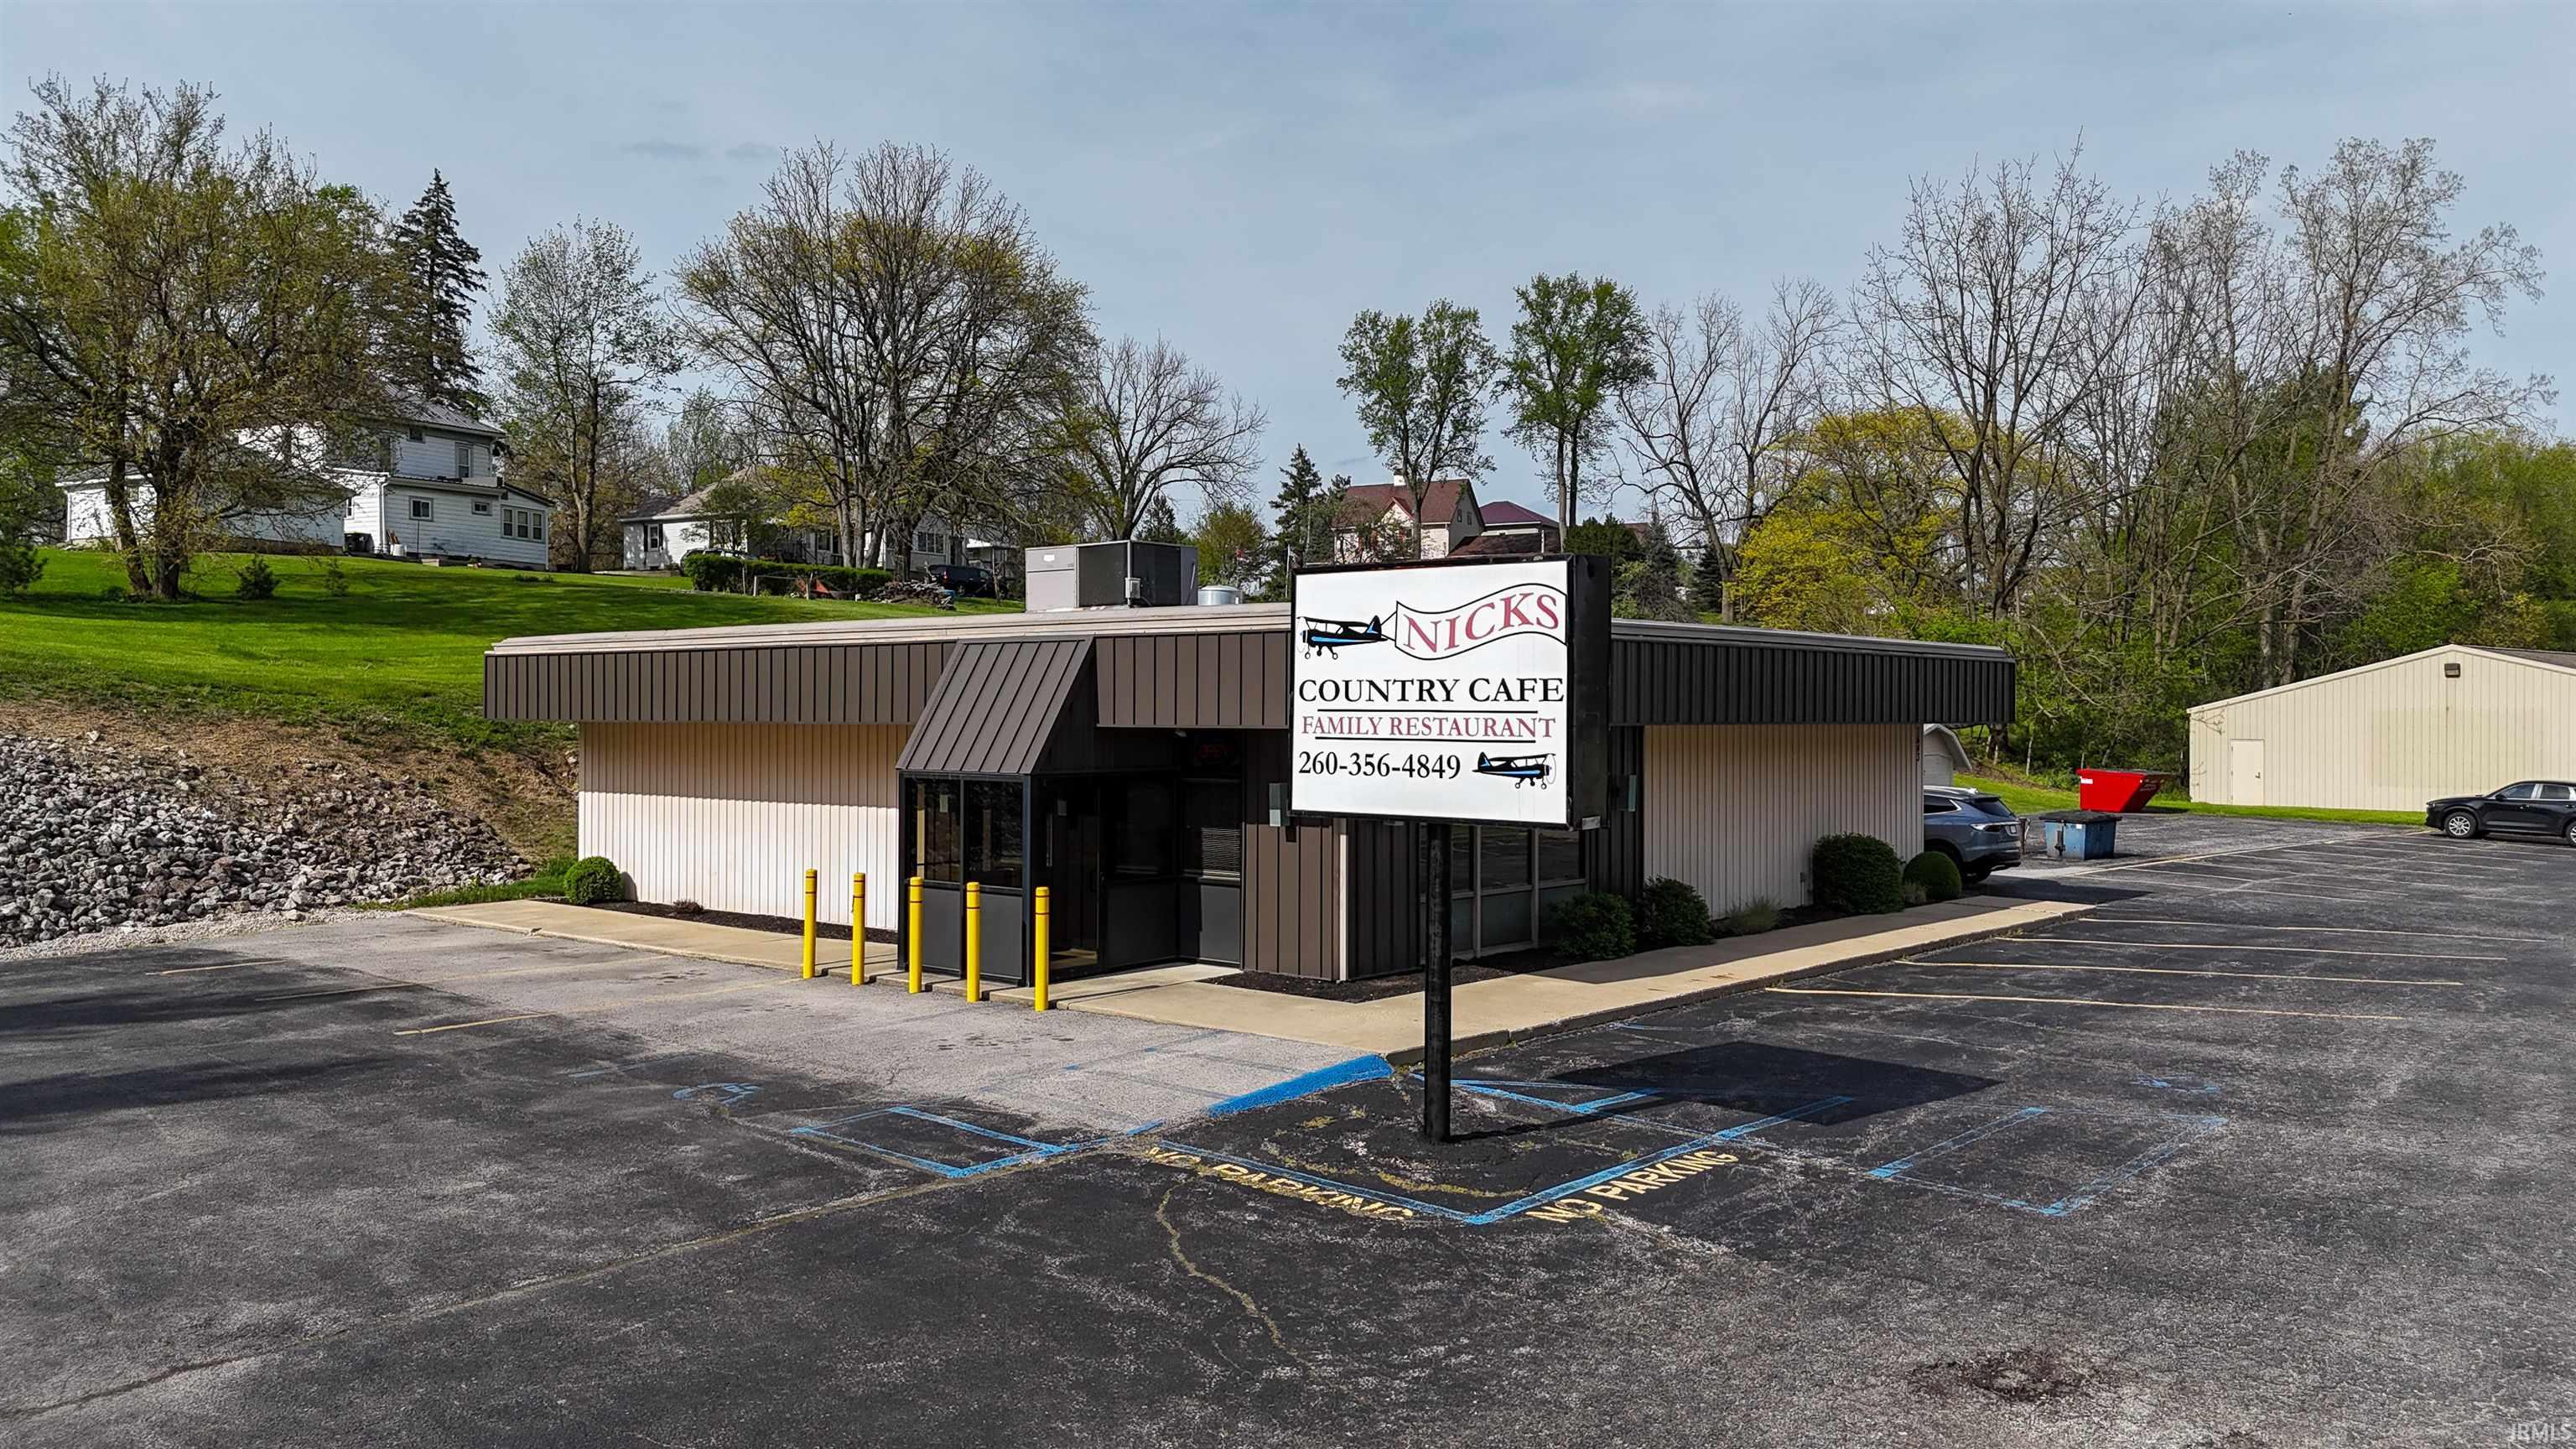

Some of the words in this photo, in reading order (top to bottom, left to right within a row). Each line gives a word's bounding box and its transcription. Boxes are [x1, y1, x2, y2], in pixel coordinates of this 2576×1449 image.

[1403, 592, 1560, 653] NICKS
[1299, 678, 1460, 703] COUNTRY
[1468, 678, 1564, 703] CAFE
[1301, 716, 1382, 735] FAMILY
[1389, 717, 1556, 738] RESTAURANT
[1299, 751, 1462, 779] 260-356-4849
[1525, 1198, 1603, 1223] NO
[1584, 1150, 1739, 1201] PARKING
